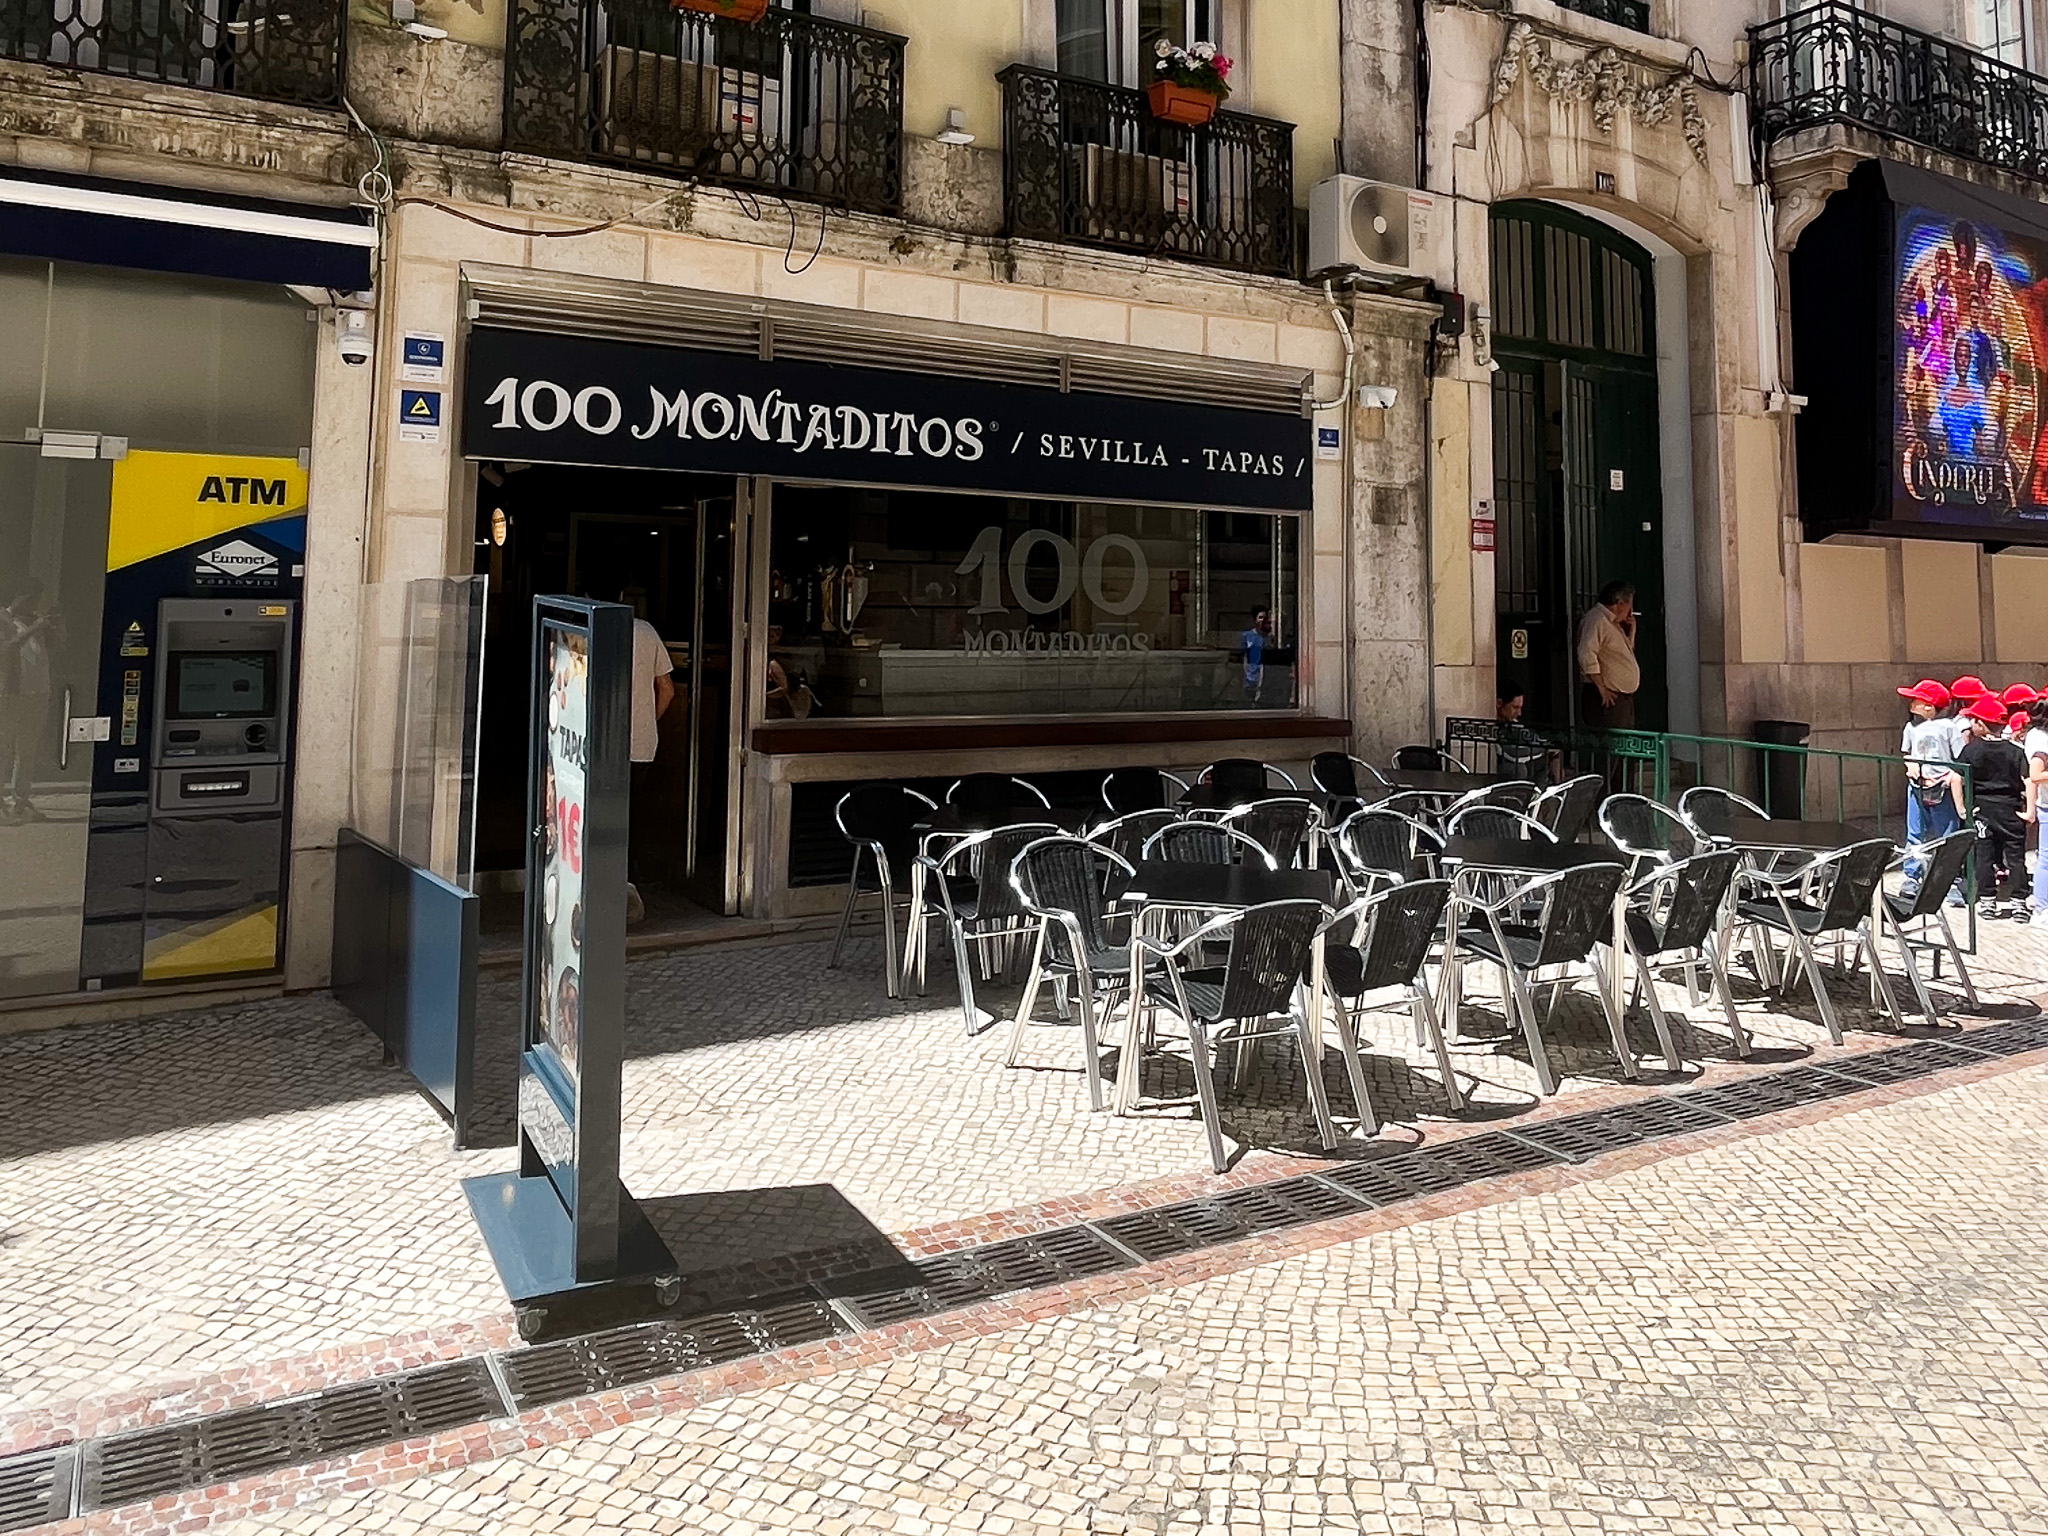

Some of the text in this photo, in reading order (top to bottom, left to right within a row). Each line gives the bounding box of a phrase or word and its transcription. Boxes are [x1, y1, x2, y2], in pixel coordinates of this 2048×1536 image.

[484, 377, 622, 435] 100
[630, 384, 984, 461] MONTADITOS
[1040, 433, 1169, 467] SEVILLA
[1202, 448, 1285, 477] TAPAS
[196, 475, 287, 506] ATM
[210, 551, 266, 566] Euronet
[954, 526, 1149, 615] 100
[962, 624, 1150, 660] MONTADITOS
[558, 795, 581, 875] 1€
